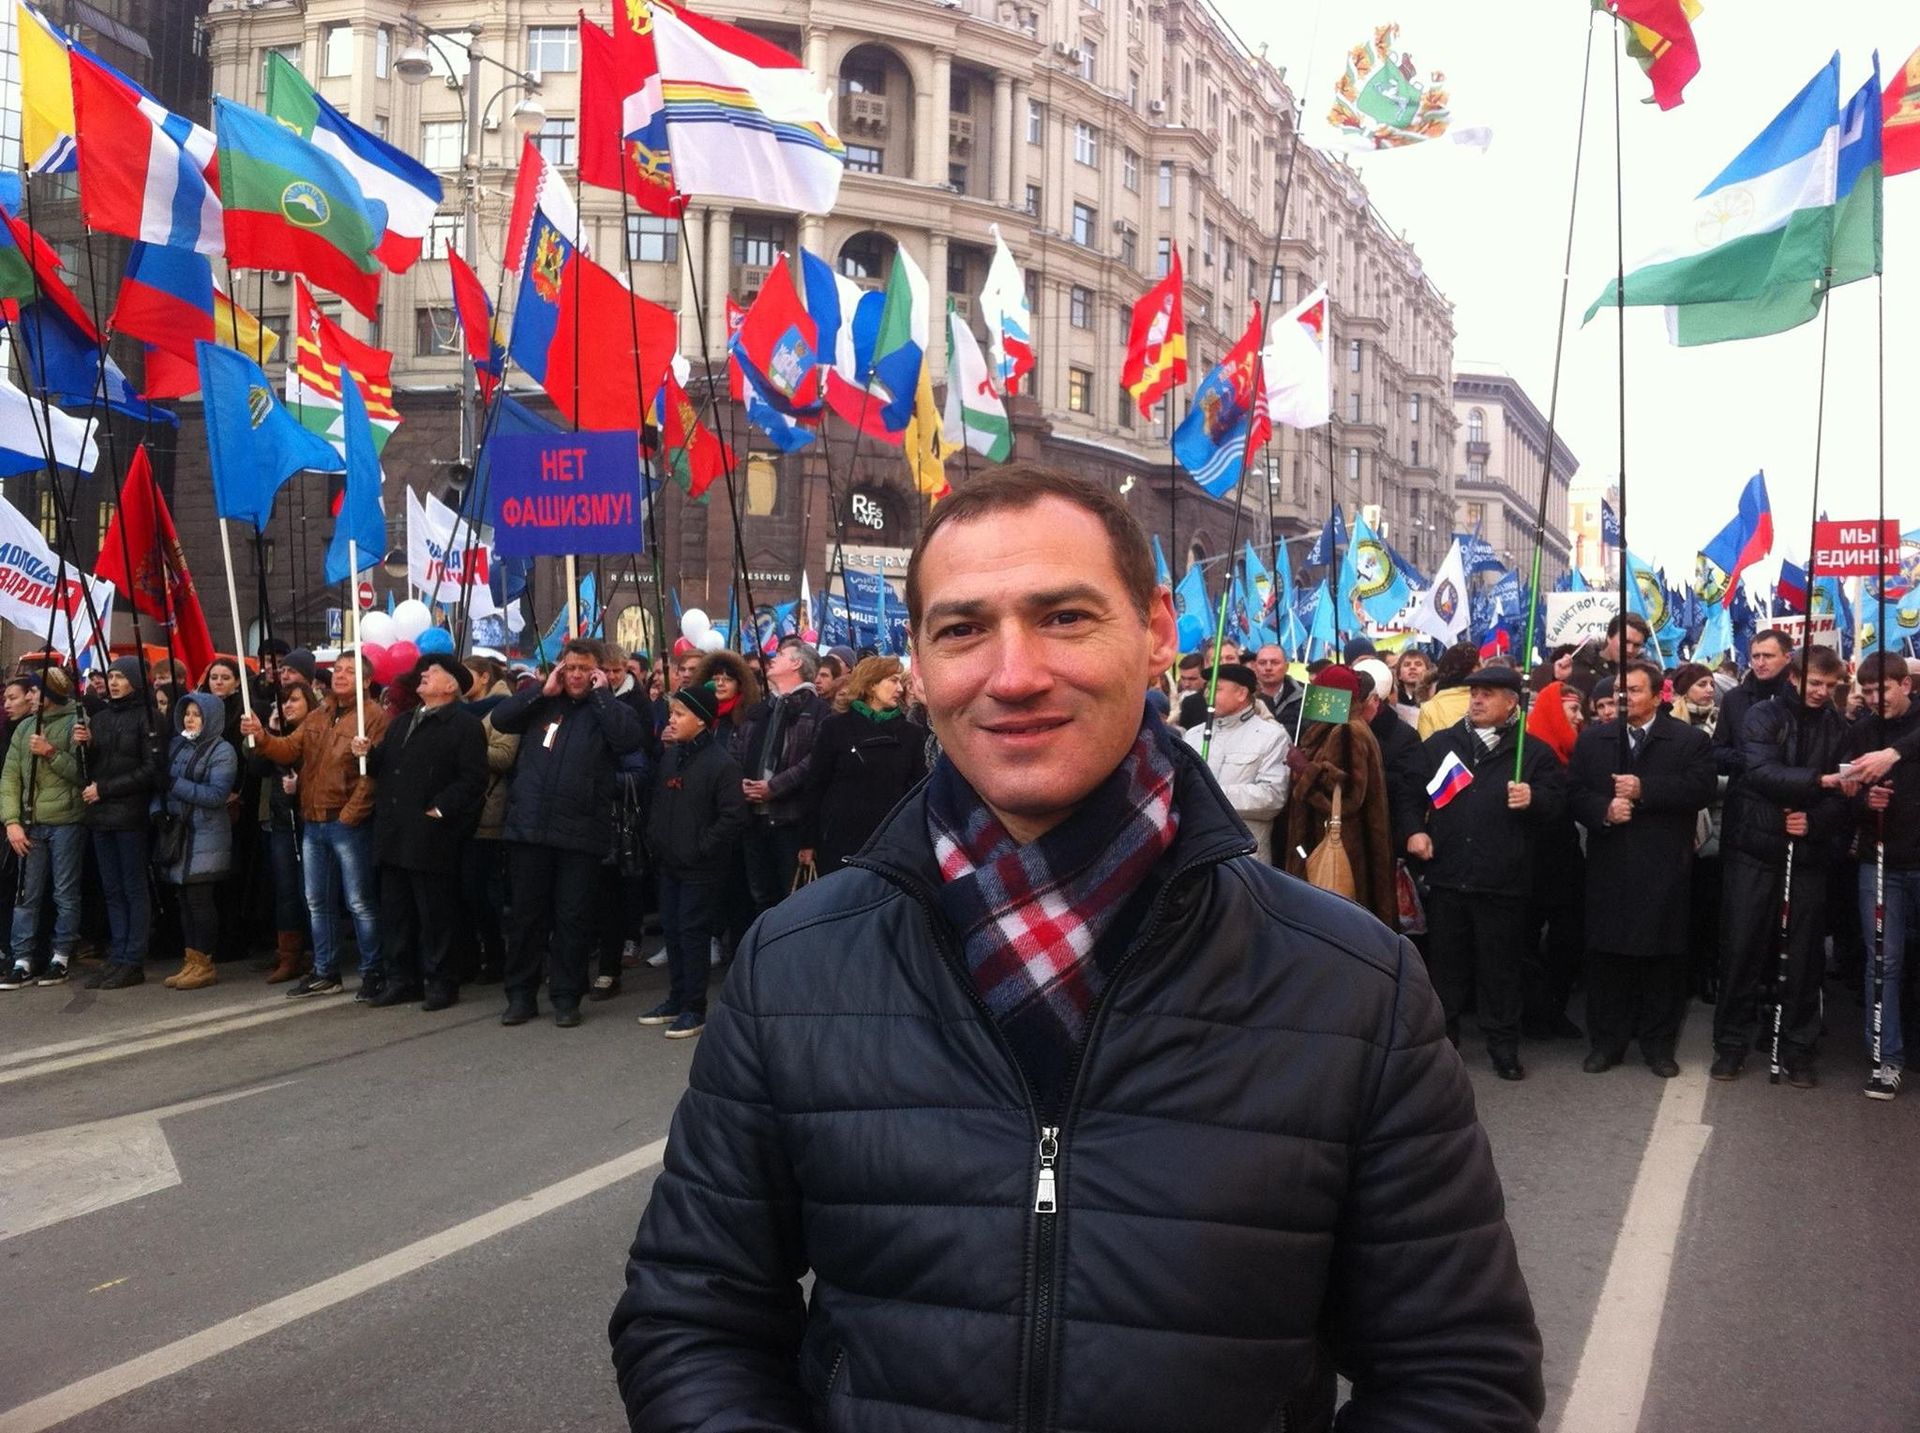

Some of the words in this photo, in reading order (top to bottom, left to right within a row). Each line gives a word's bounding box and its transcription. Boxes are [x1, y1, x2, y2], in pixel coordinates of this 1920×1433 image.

[541, 448, 587, 481] НЕТ
[502, 492, 633, 527] ФАШИЗМУ!
[1840, 527, 1877, 544] МЫ
[1816, 548, 1900, 568] ЕДИНЫ!
